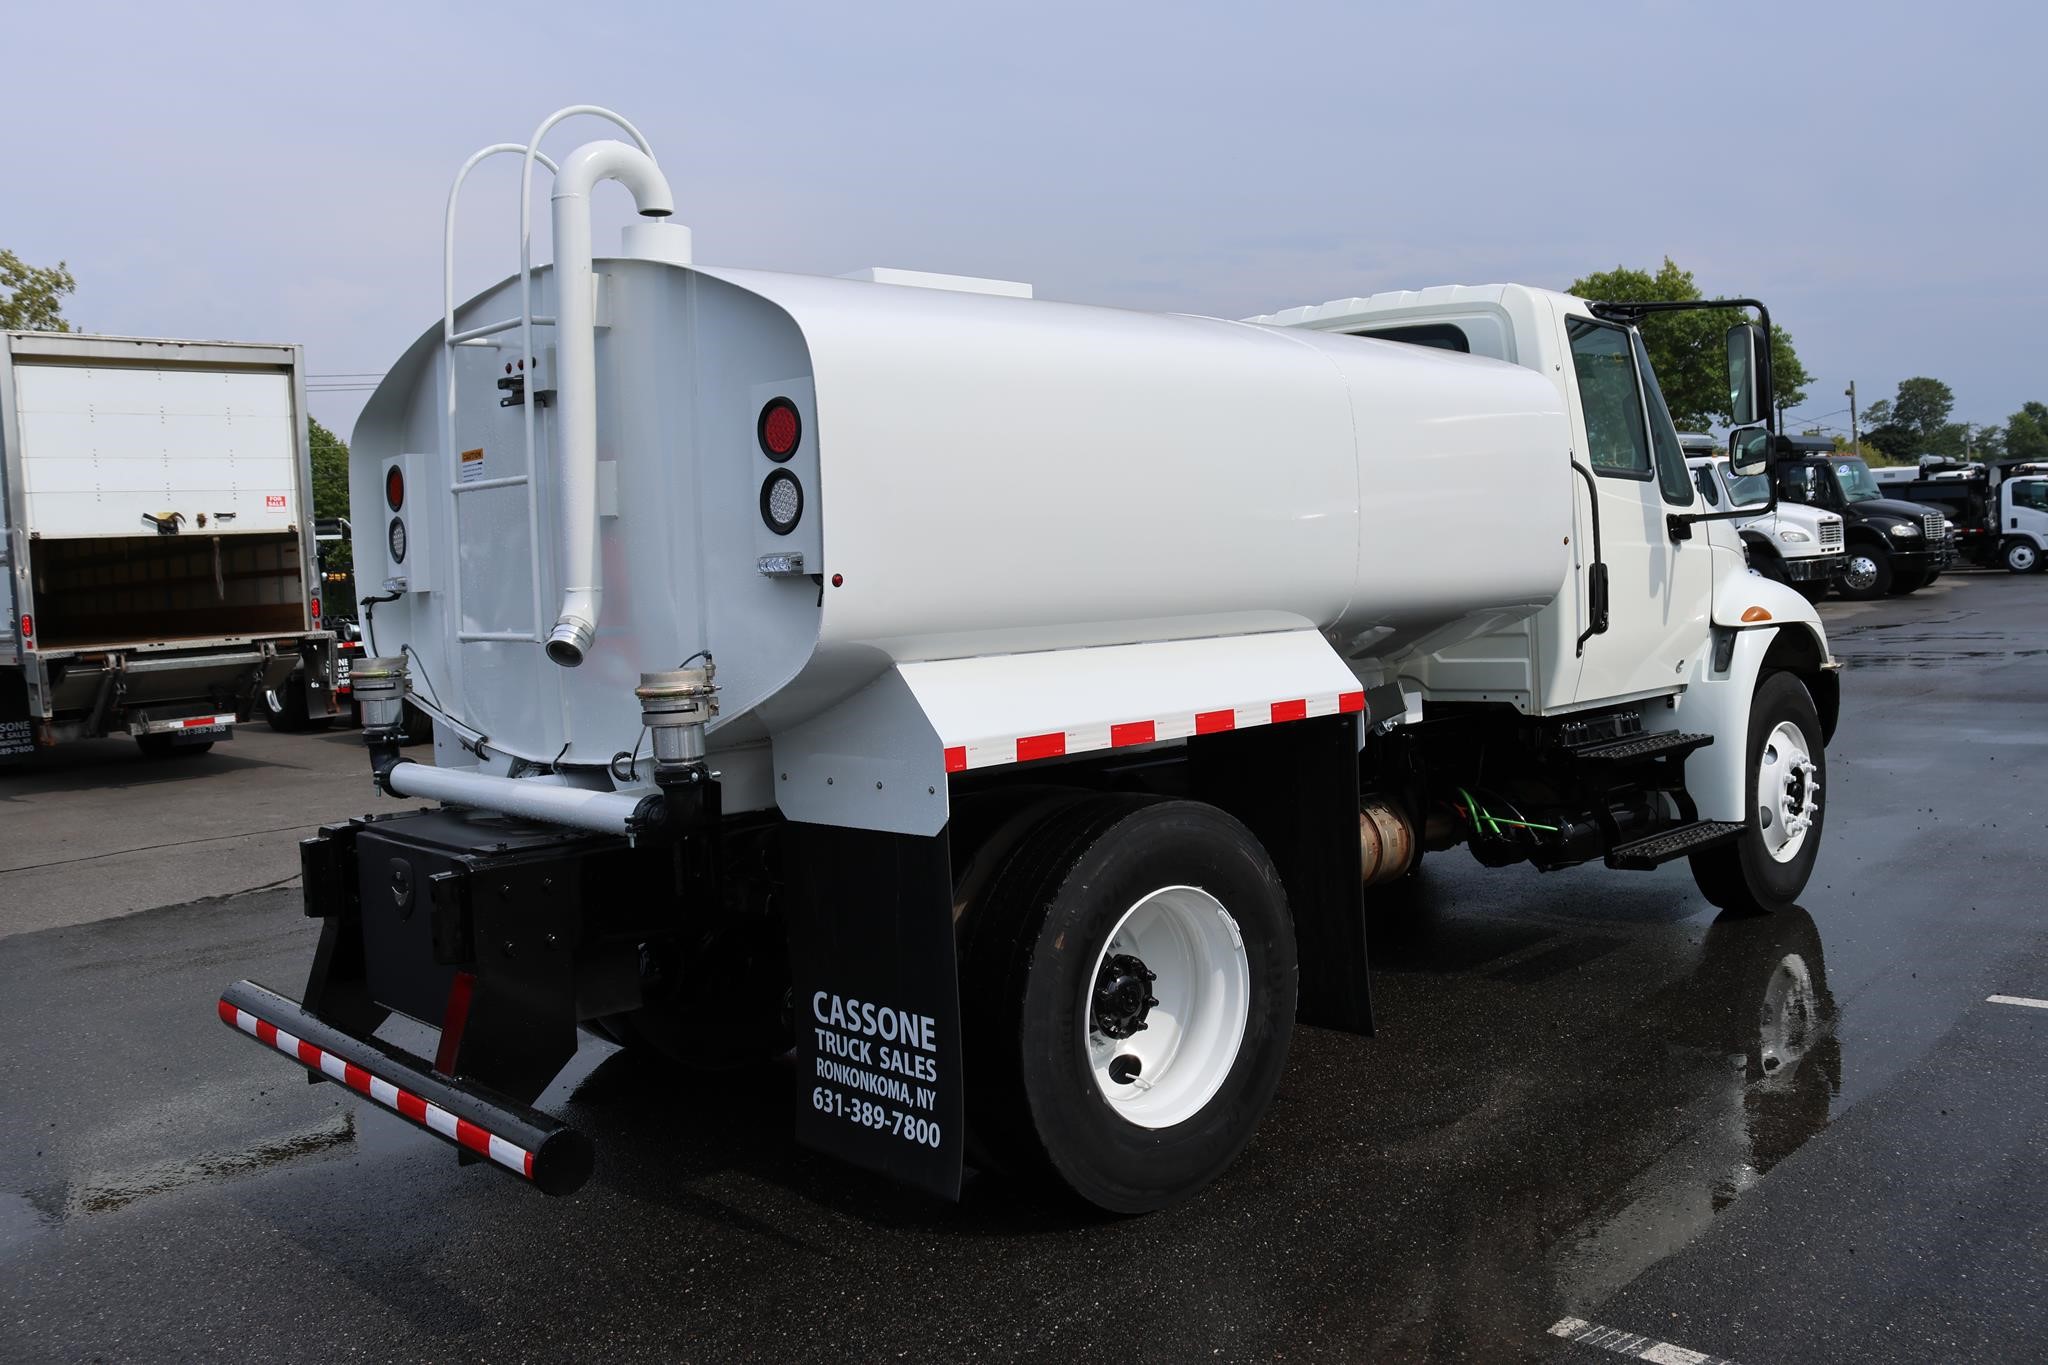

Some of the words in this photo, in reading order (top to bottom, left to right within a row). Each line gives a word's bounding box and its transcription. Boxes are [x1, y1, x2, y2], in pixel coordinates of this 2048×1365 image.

[7, 730, 32, 739] SALES
[813, 990, 938, 1053] CASSONE
[814, 1027, 873, 1066] TRUCK
[879, 1046, 937, 1083] SALES
[816, 1056, 914, 1108] RONKONKOMA,
[916, 1086, 937, 1111] NY
[812, 1086, 941, 1149] 631-389-7800
